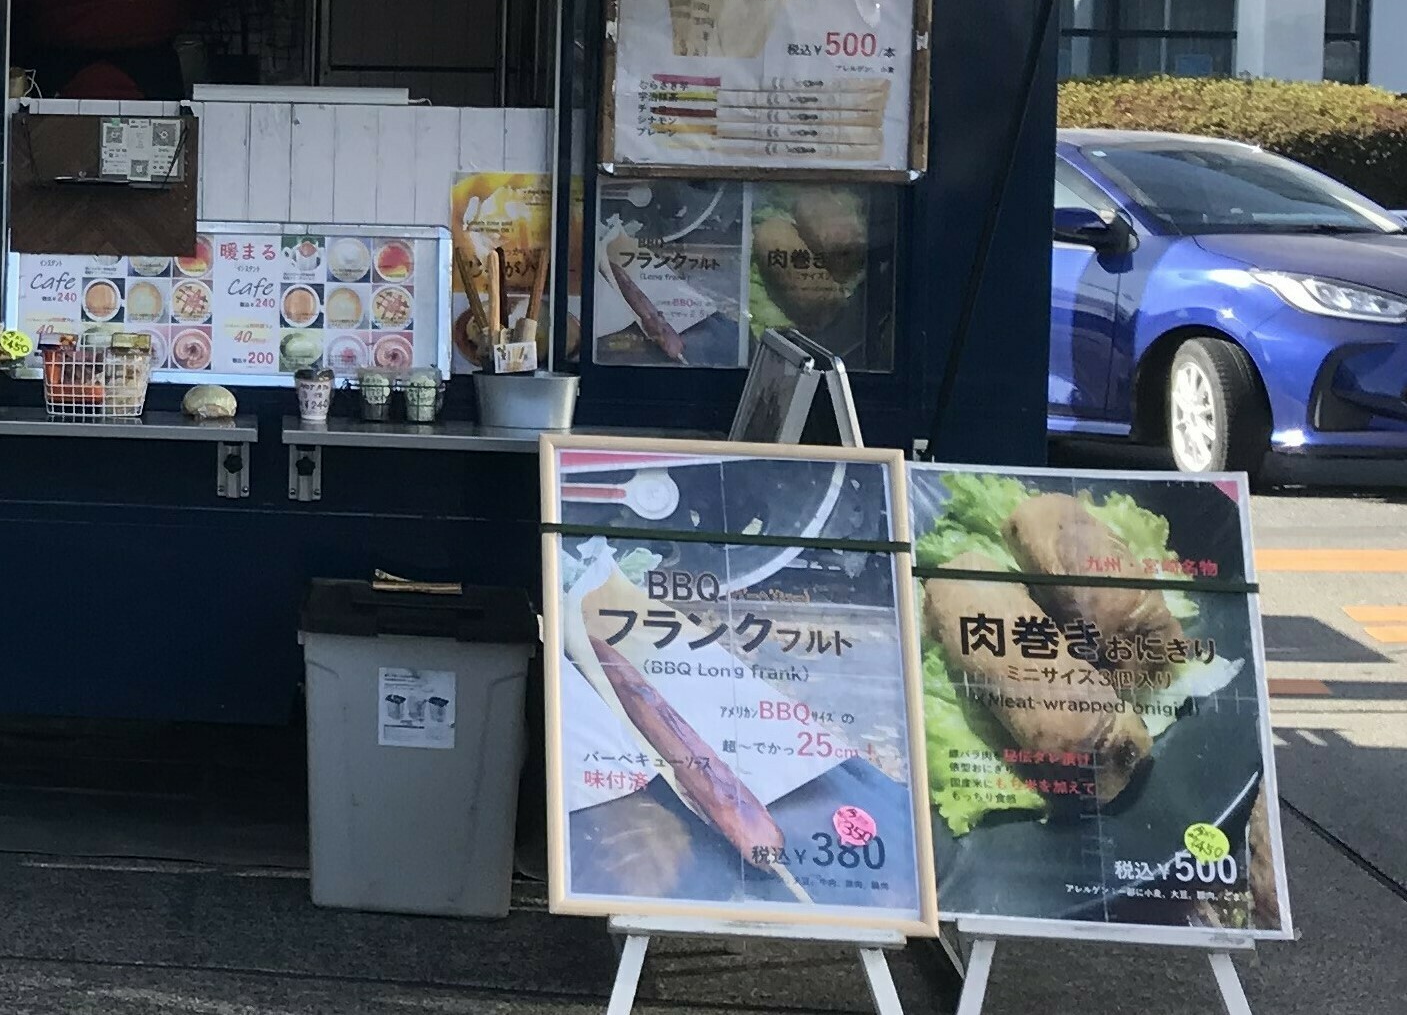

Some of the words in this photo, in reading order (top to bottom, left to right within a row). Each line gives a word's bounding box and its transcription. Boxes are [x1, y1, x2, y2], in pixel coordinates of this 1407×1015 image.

[220, 242, 276, 261] 暖まる
[647, 570, 721, 603] BBQ
[598, 608, 854, 657] フランクフルト
[959, 613, 1217, 666] 肉巻きおにぎり
[643, 659, 692, 677] (BBQ
[698, 663, 744, 679] Long
[751, 665, 809, 682] frank)
